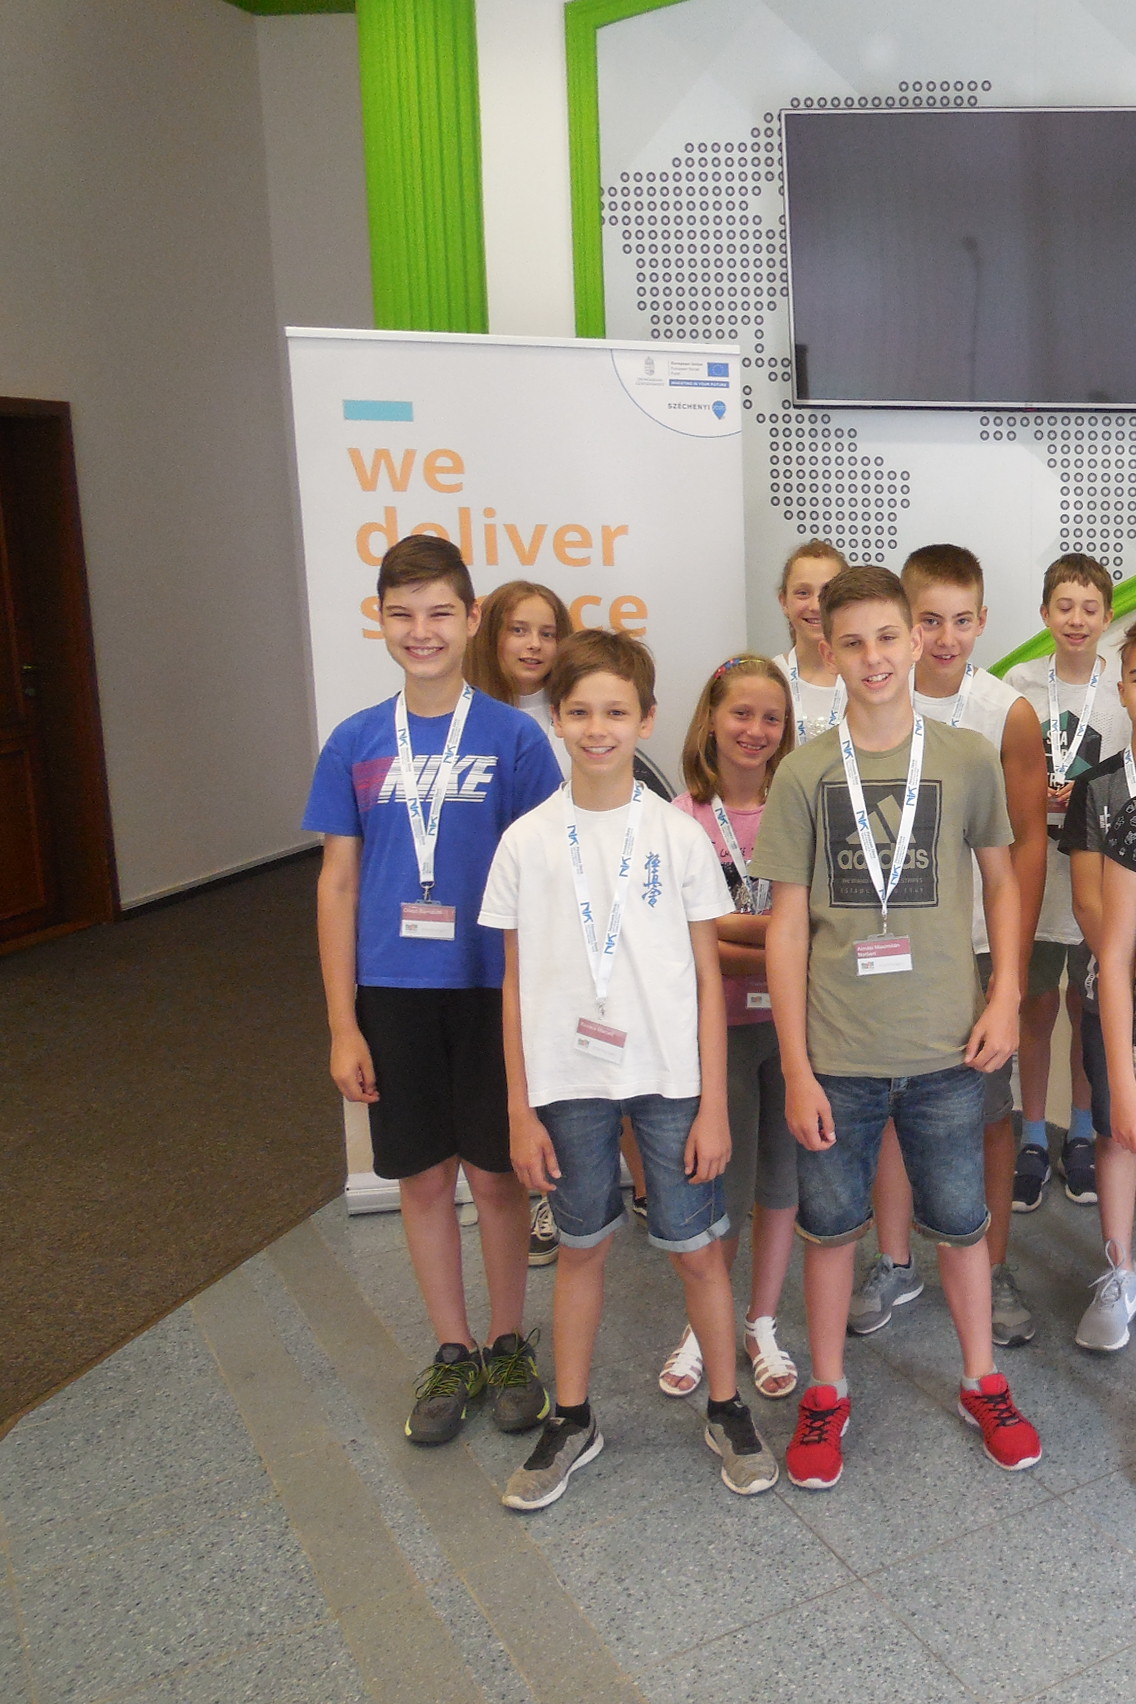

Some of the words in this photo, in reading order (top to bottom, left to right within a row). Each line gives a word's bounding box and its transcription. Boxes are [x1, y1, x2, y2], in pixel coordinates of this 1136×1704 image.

[667, 402, 710, 411] SZÉCHENYI
[347, 446, 465, 493] we
[377, 755, 498, 804] NIKE
[837, 843, 930, 870] addas
